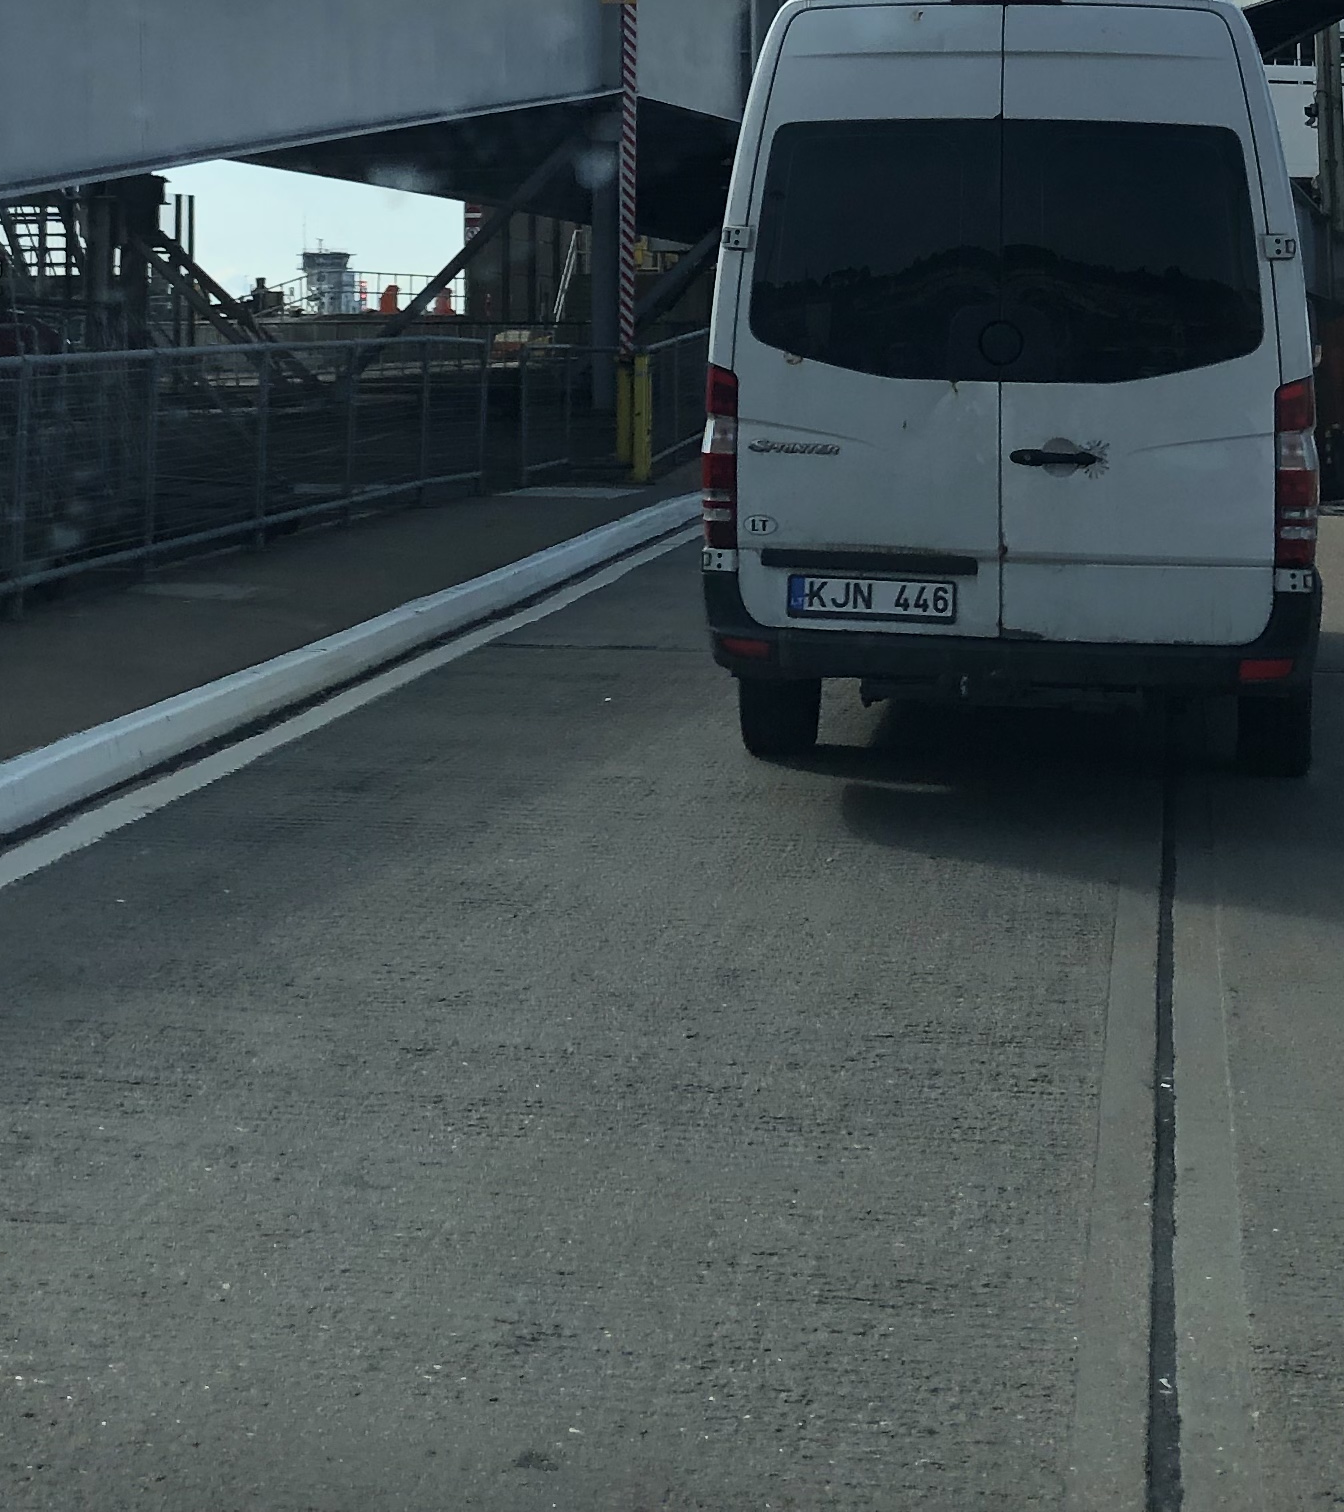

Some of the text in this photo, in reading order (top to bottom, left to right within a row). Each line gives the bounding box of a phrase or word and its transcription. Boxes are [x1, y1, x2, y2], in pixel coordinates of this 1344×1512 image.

[751, 518, 769, 531] LT
[808, 581, 949, 614] KJN 446
